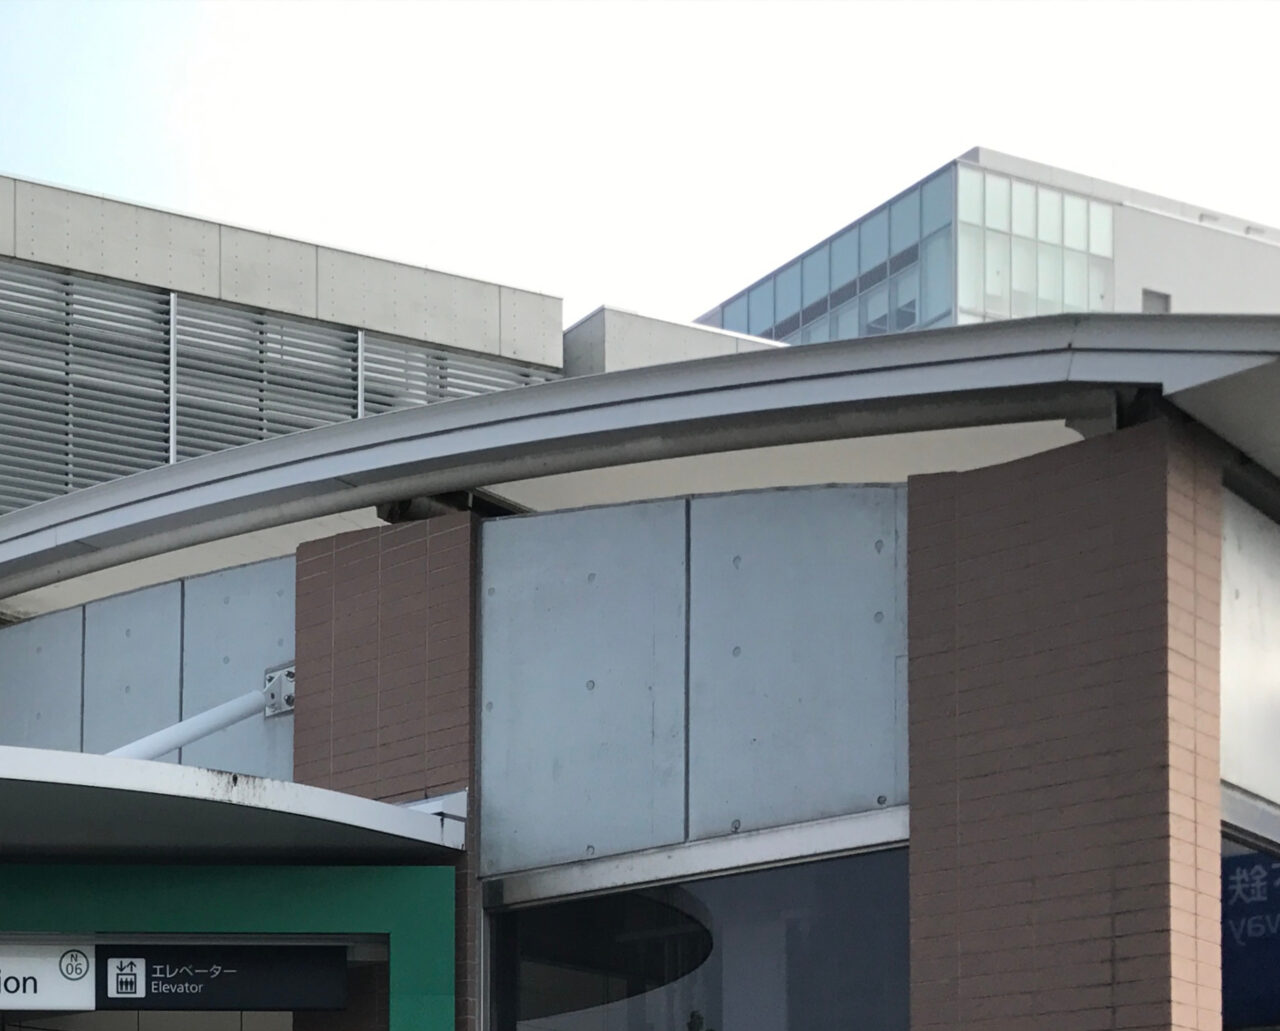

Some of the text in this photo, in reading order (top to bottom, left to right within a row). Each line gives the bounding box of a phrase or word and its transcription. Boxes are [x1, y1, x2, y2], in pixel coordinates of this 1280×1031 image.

[70, 953, 78, 963] N
[65, 963, 83, 976] 06
[151, 964, 237, 979] エレベーター
[151, 980, 204, 994] Elevator
